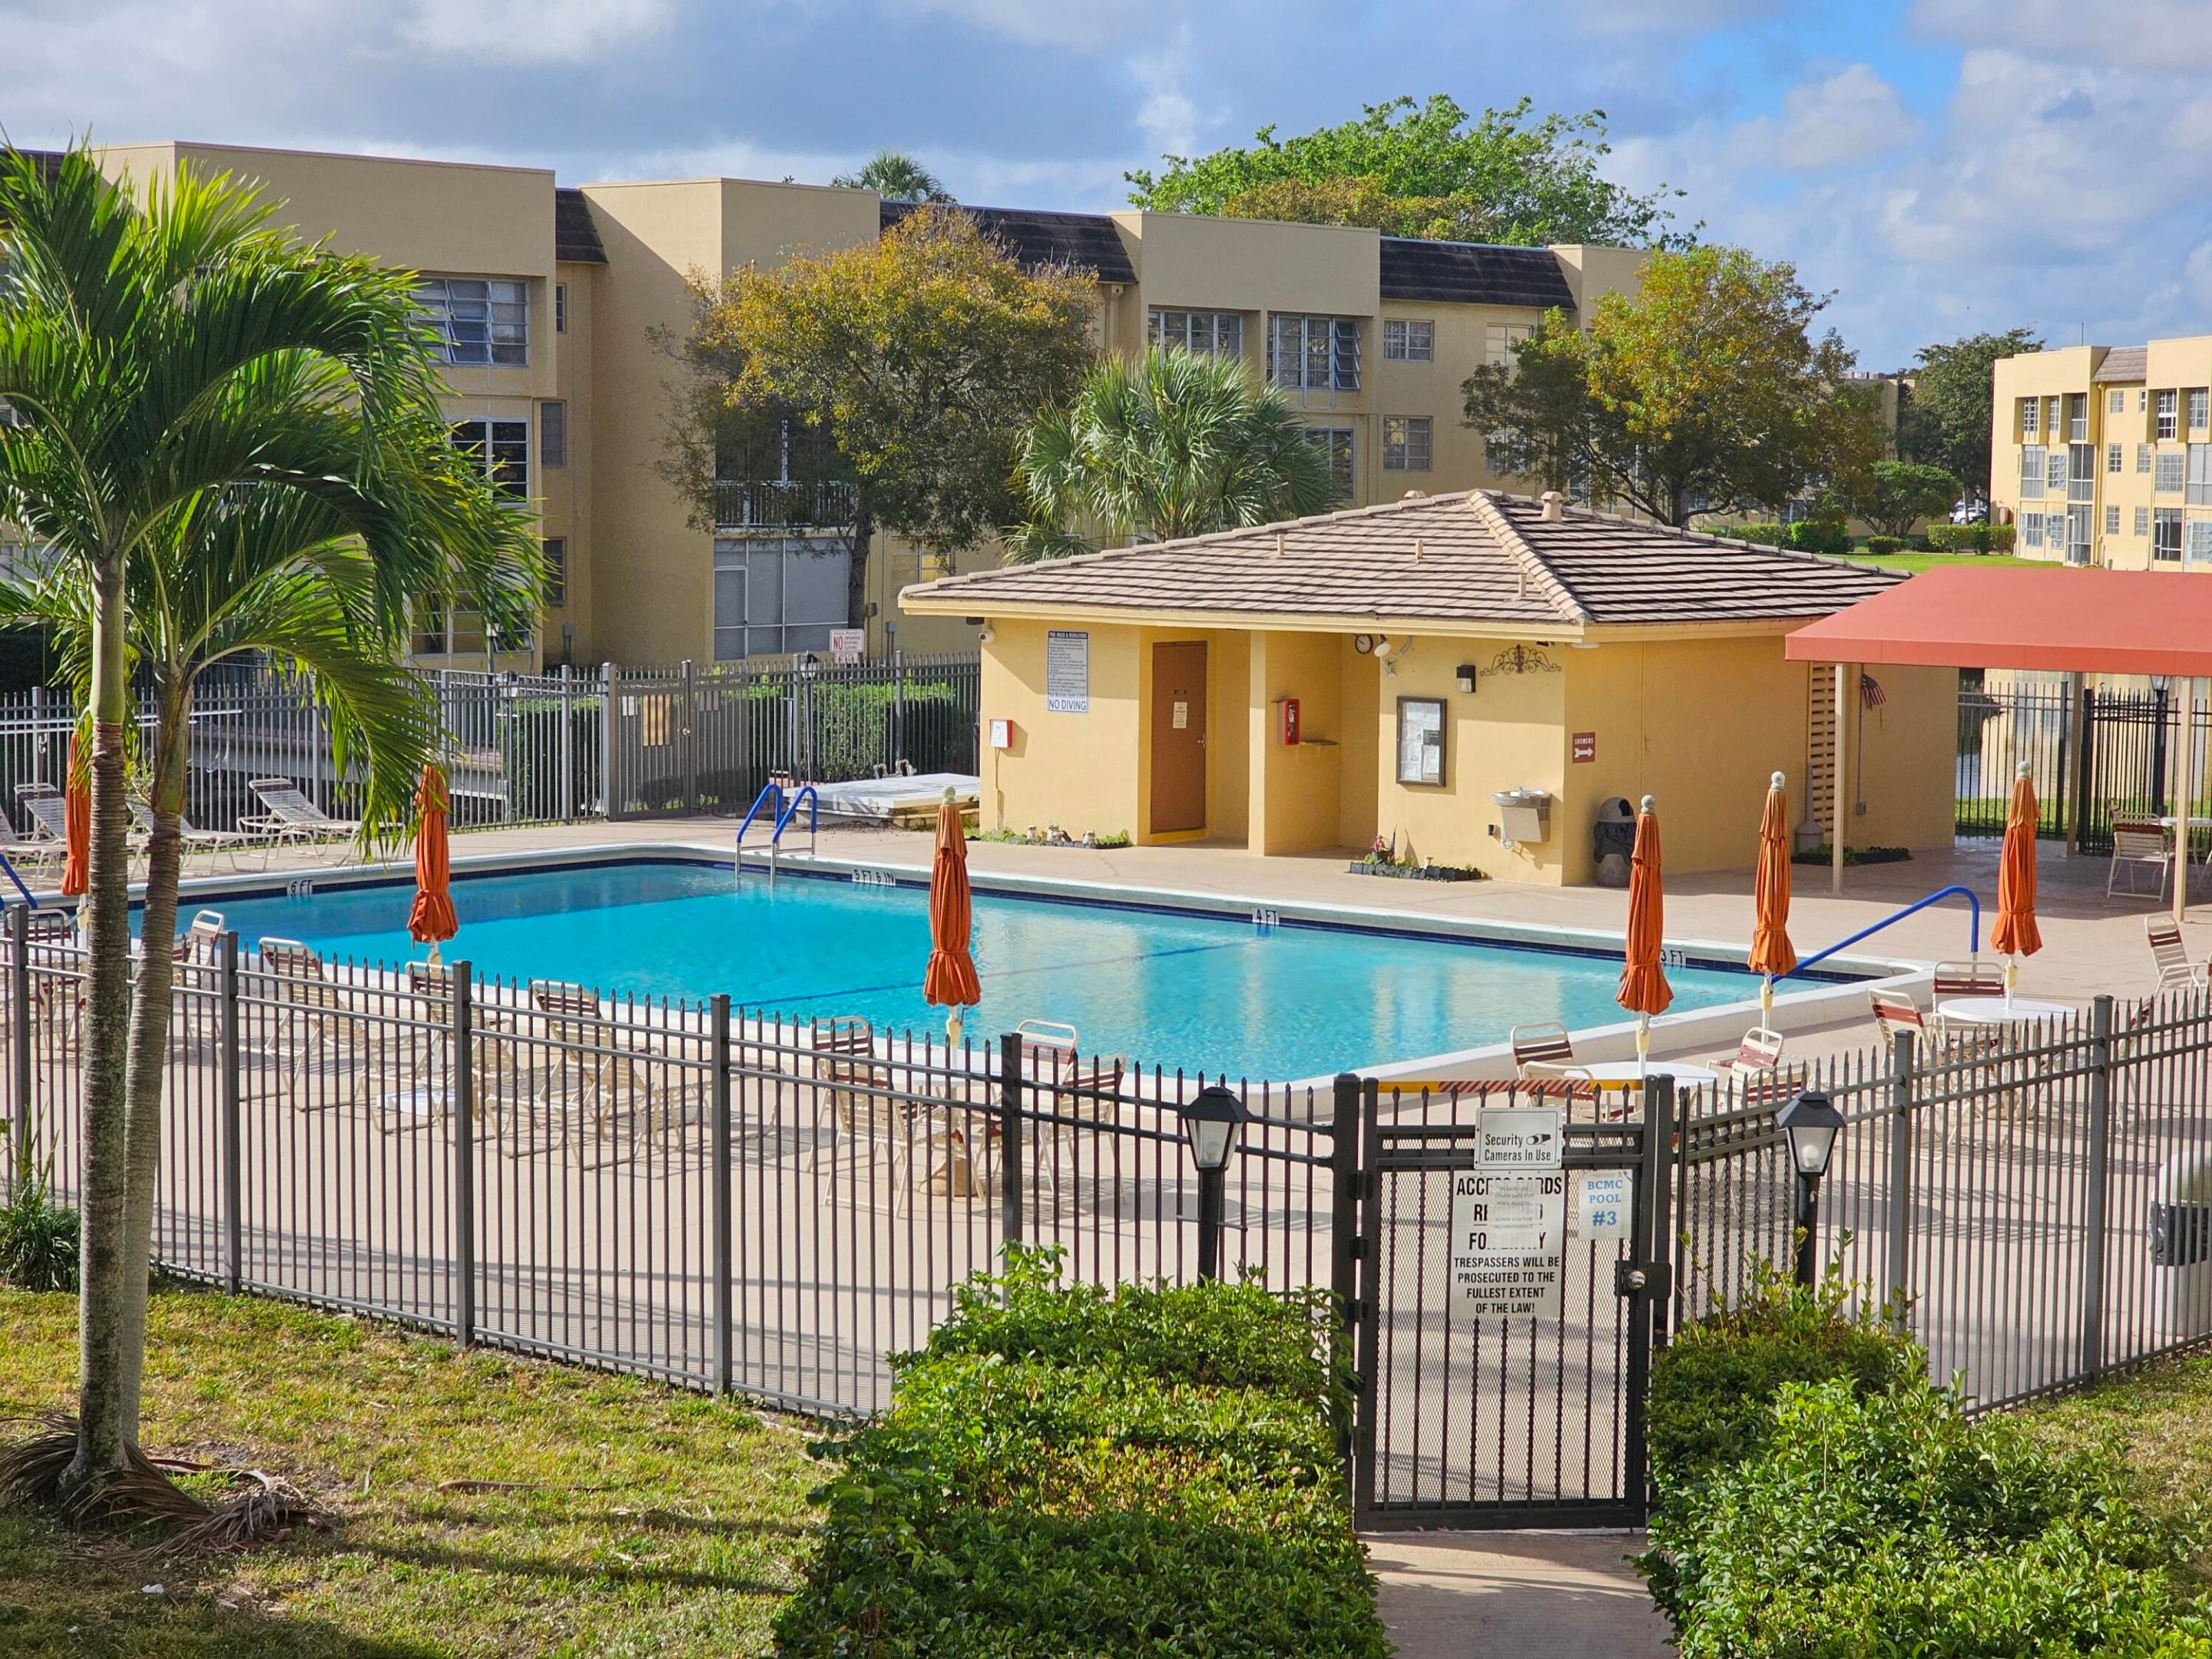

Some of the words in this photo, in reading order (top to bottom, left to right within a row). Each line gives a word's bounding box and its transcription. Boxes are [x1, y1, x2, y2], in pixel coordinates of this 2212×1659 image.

[833, 636, 843, 651] NO
[1049, 699, 1060, 710] NO
[1061, 700, 1087, 710] DIVING
[854, 869, 860, 881] 5
[861, 869, 873, 882] FT
[876, 871, 882, 882] 6
[883, 872, 895, 884] IN
[291, 881, 297, 893] 6
[300, 879, 313, 893] FT
[1257, 909, 1263, 922] 4
[1265, 909, 1277, 923] FT
[1660, 949, 1667, 962] 3
[1670, 949, 1683, 964] FT
[1485, 1134, 1523, 1148] Security
[1485, 1149, 1522, 1161] Cameras
[1525, 1149, 1533, 1161] In
[1536, 1149, 1551, 1161] Use
[1588, 1180, 1623, 1190] BCMC
[1588, 1194, 1621, 1204] POOL
[1593, 1210, 1617, 1227] #3
[1455, 1257, 1519, 1268] TRESPASSERS
[1522, 1257, 1545, 1267] WILL
[1548, 1257, 1560, 1267] BE
[1458, 1273, 1519, 1283] PROSECUTED
[1522, 1272, 1534, 1283] TO
[1538, 1272, 1555, 1282] THE
[1467, 1288, 1506, 1299] FULLEST
[1509, 1287, 1545, 1298] EXTENT
[1476, 1303, 1488, 1313] OF
[1491, 1303, 1508, 1313] THE
[1512, 1303, 1535, 1313] LAW!
